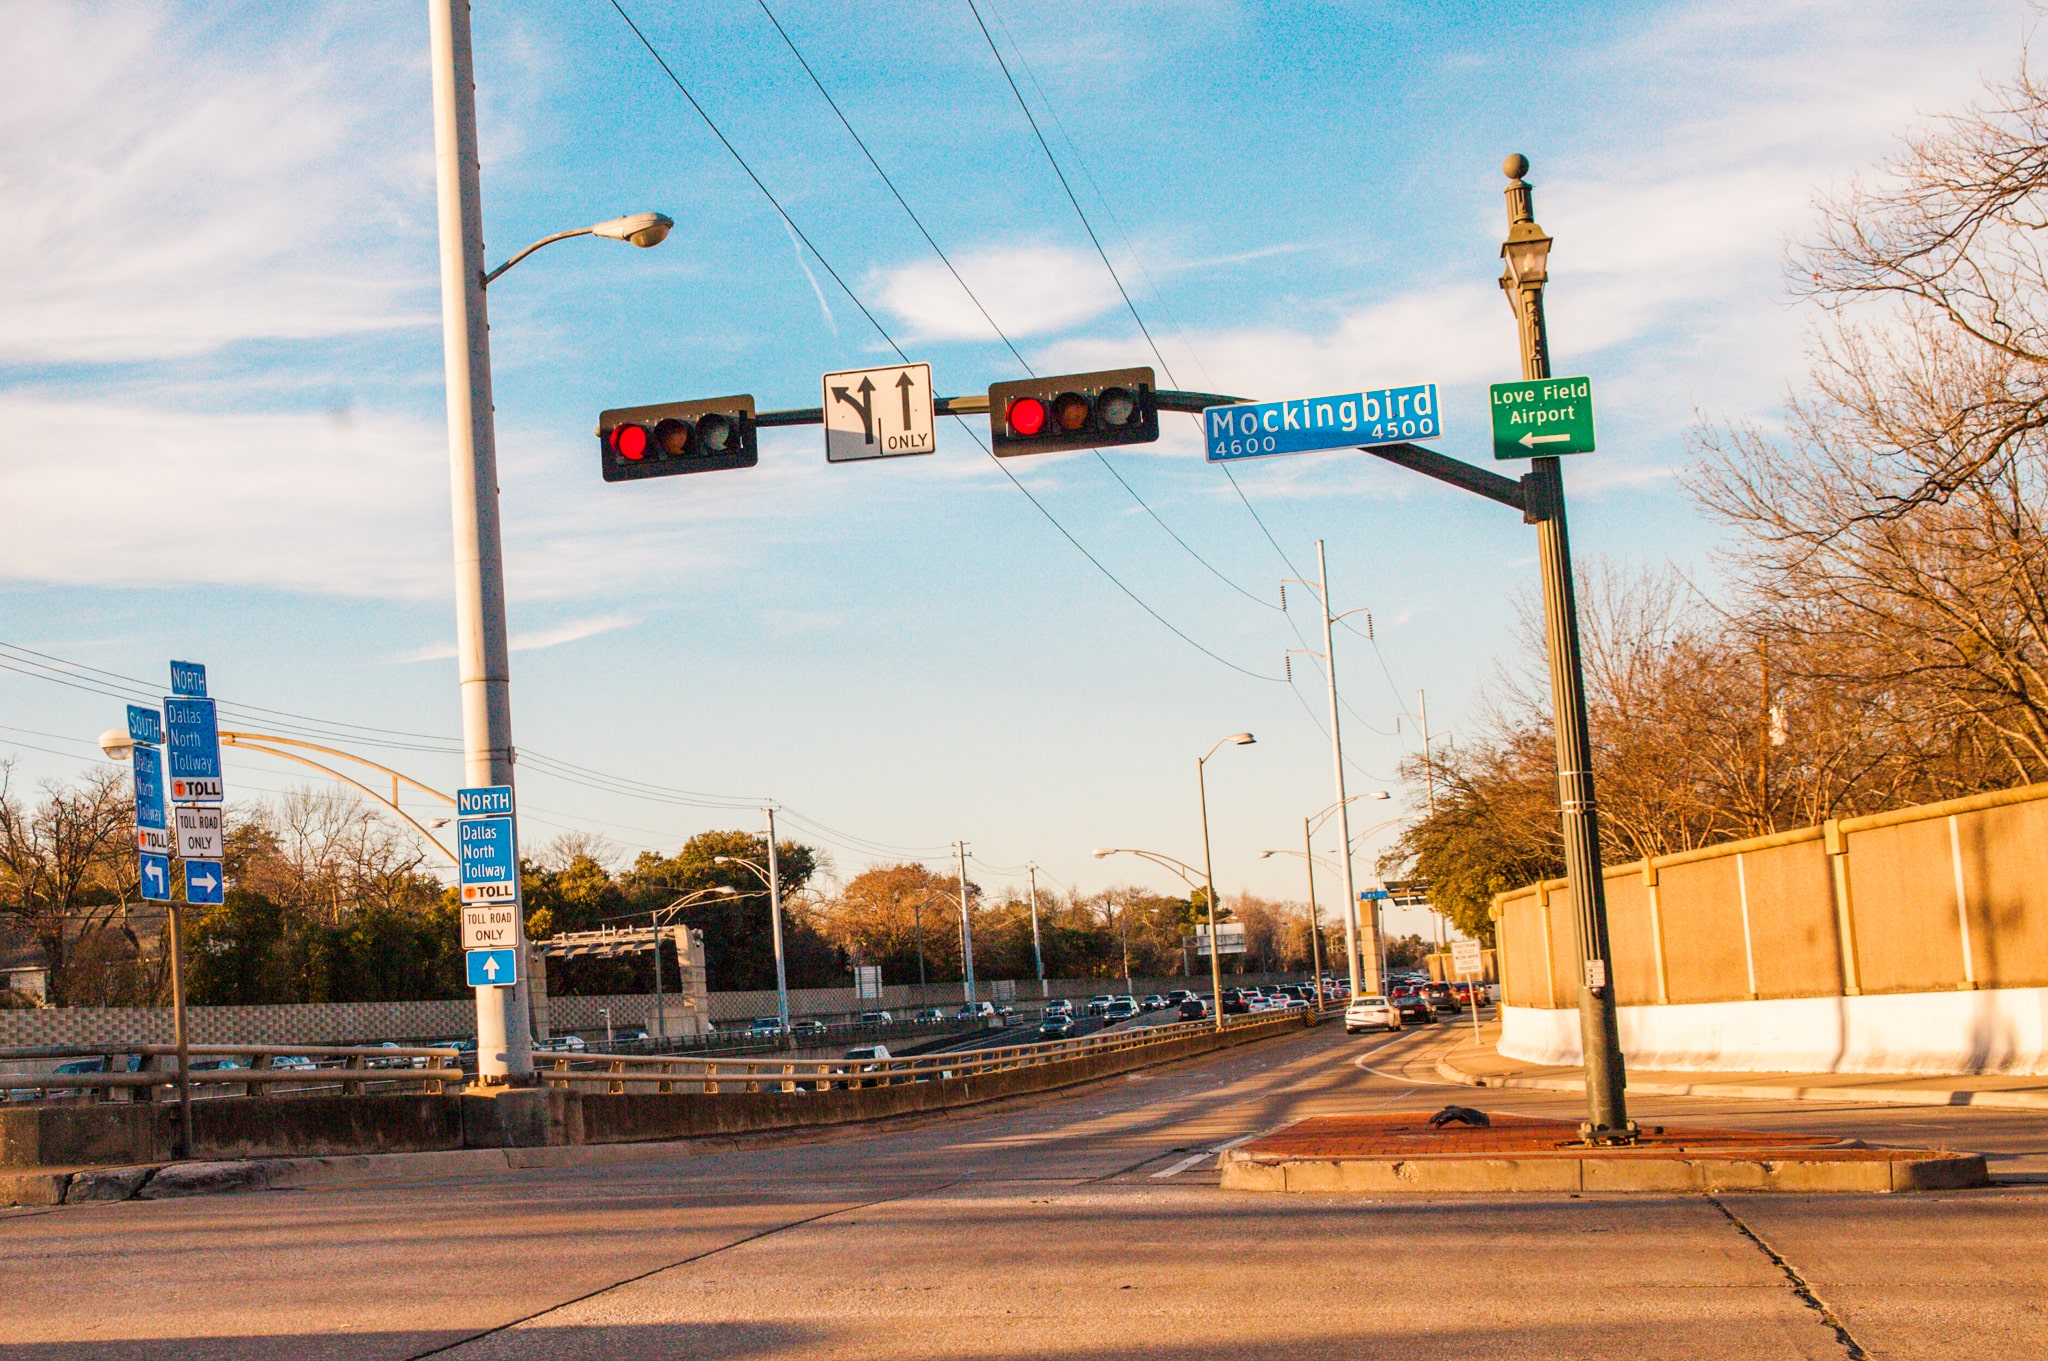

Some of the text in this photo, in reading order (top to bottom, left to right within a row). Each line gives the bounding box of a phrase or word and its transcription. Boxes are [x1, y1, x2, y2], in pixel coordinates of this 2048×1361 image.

[1493, 382, 1588, 405] Love Field
[1212, 385, 1433, 438] Mockingbird
[1510, 405, 1575, 426] Airport
[1371, 418, 1434, 440] 4500
[888, 433, 928, 450] ONLY
[1215, 436, 1277, 457] 4600
[172, 667, 206, 692] NORTH
[168, 705, 201, 724] Dallas
[130, 711, 160, 739] SOUTH
[171, 728, 201, 747] North
[172, 752, 212, 775] Tollway
[186, 781, 220, 797] TOLL
[138, 800, 161, 824] Tollway
[460, 793, 510, 812] NORTH
[180, 815, 218, 830] TOLL ROAD
[147, 833, 166, 848] TOLL
[188, 836, 212, 849] ONLY
[463, 825, 497, 841] Dallas
[463, 844, 495, 860] North
[464, 863, 506, 880] Tollway
[477, 885, 513, 898] TOLL
[468, 912, 512, 925] TOLL ROAD
[475, 929, 504, 941] ONLY
